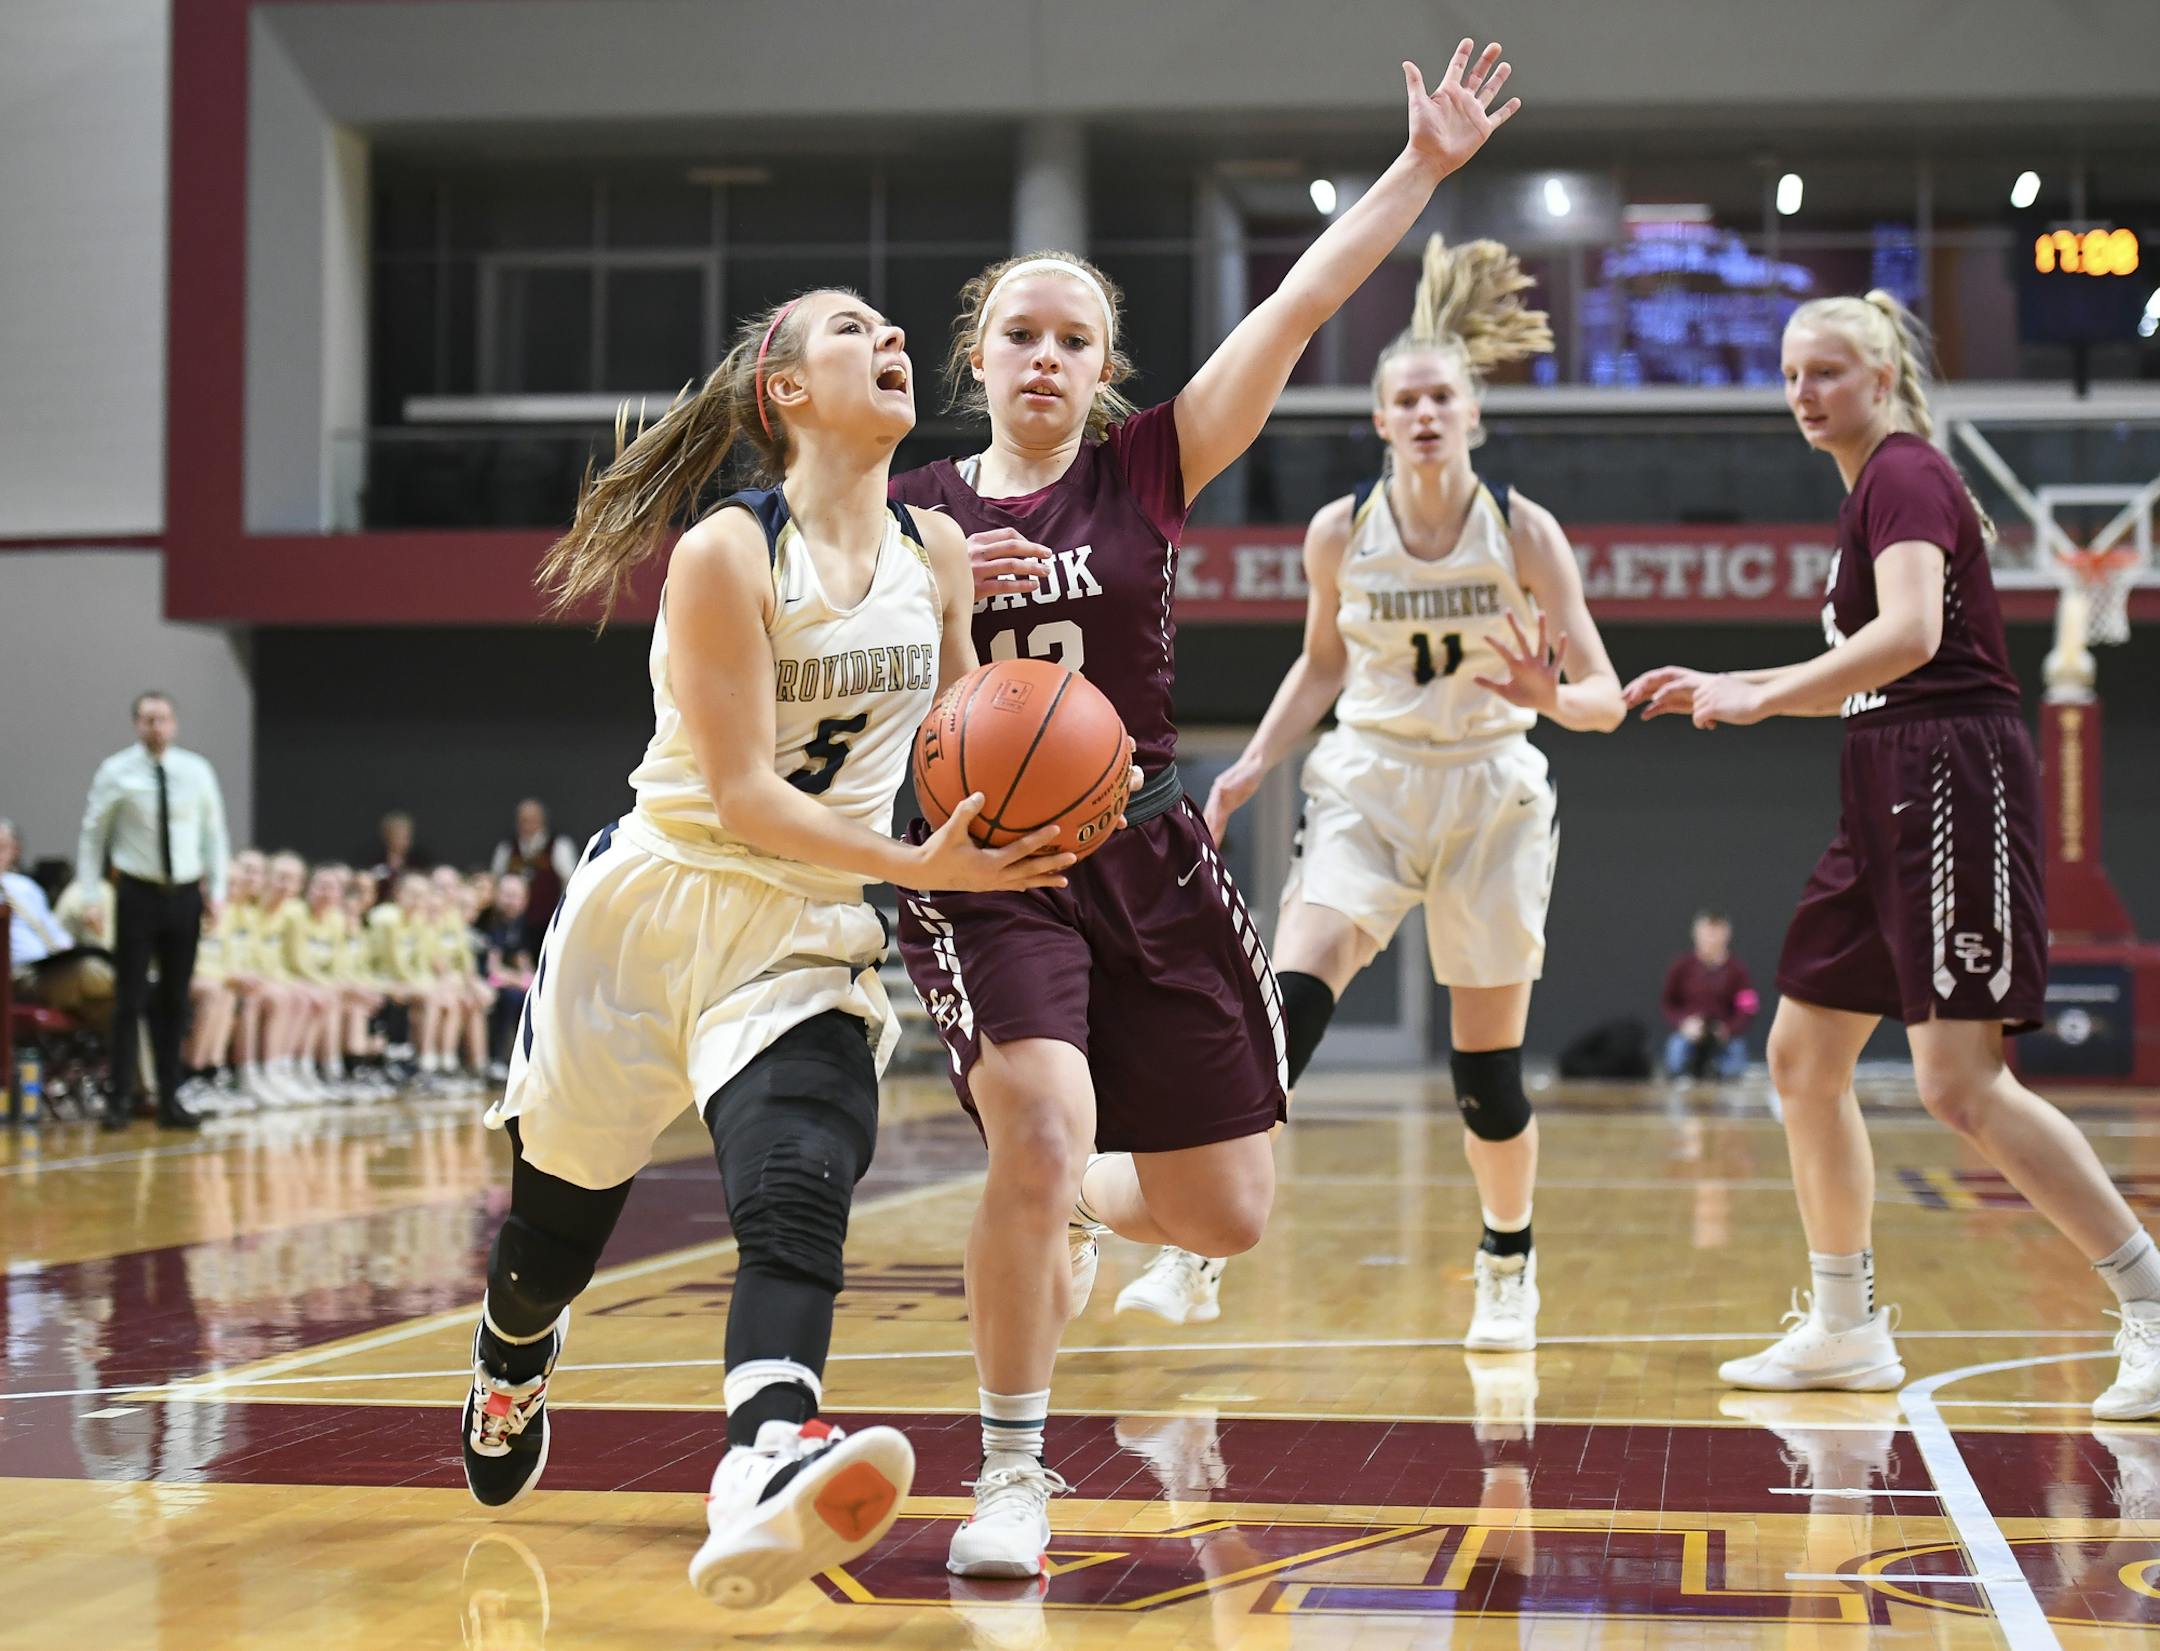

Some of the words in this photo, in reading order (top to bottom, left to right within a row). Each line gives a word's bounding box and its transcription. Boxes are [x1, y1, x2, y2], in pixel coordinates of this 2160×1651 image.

[1367, 583, 1500, 621] PROVIDENCE
[774, 643, 933, 703] ROVIDENCE
[1411, 632, 1464, 685] 11
[783, 711, 872, 796] 5
